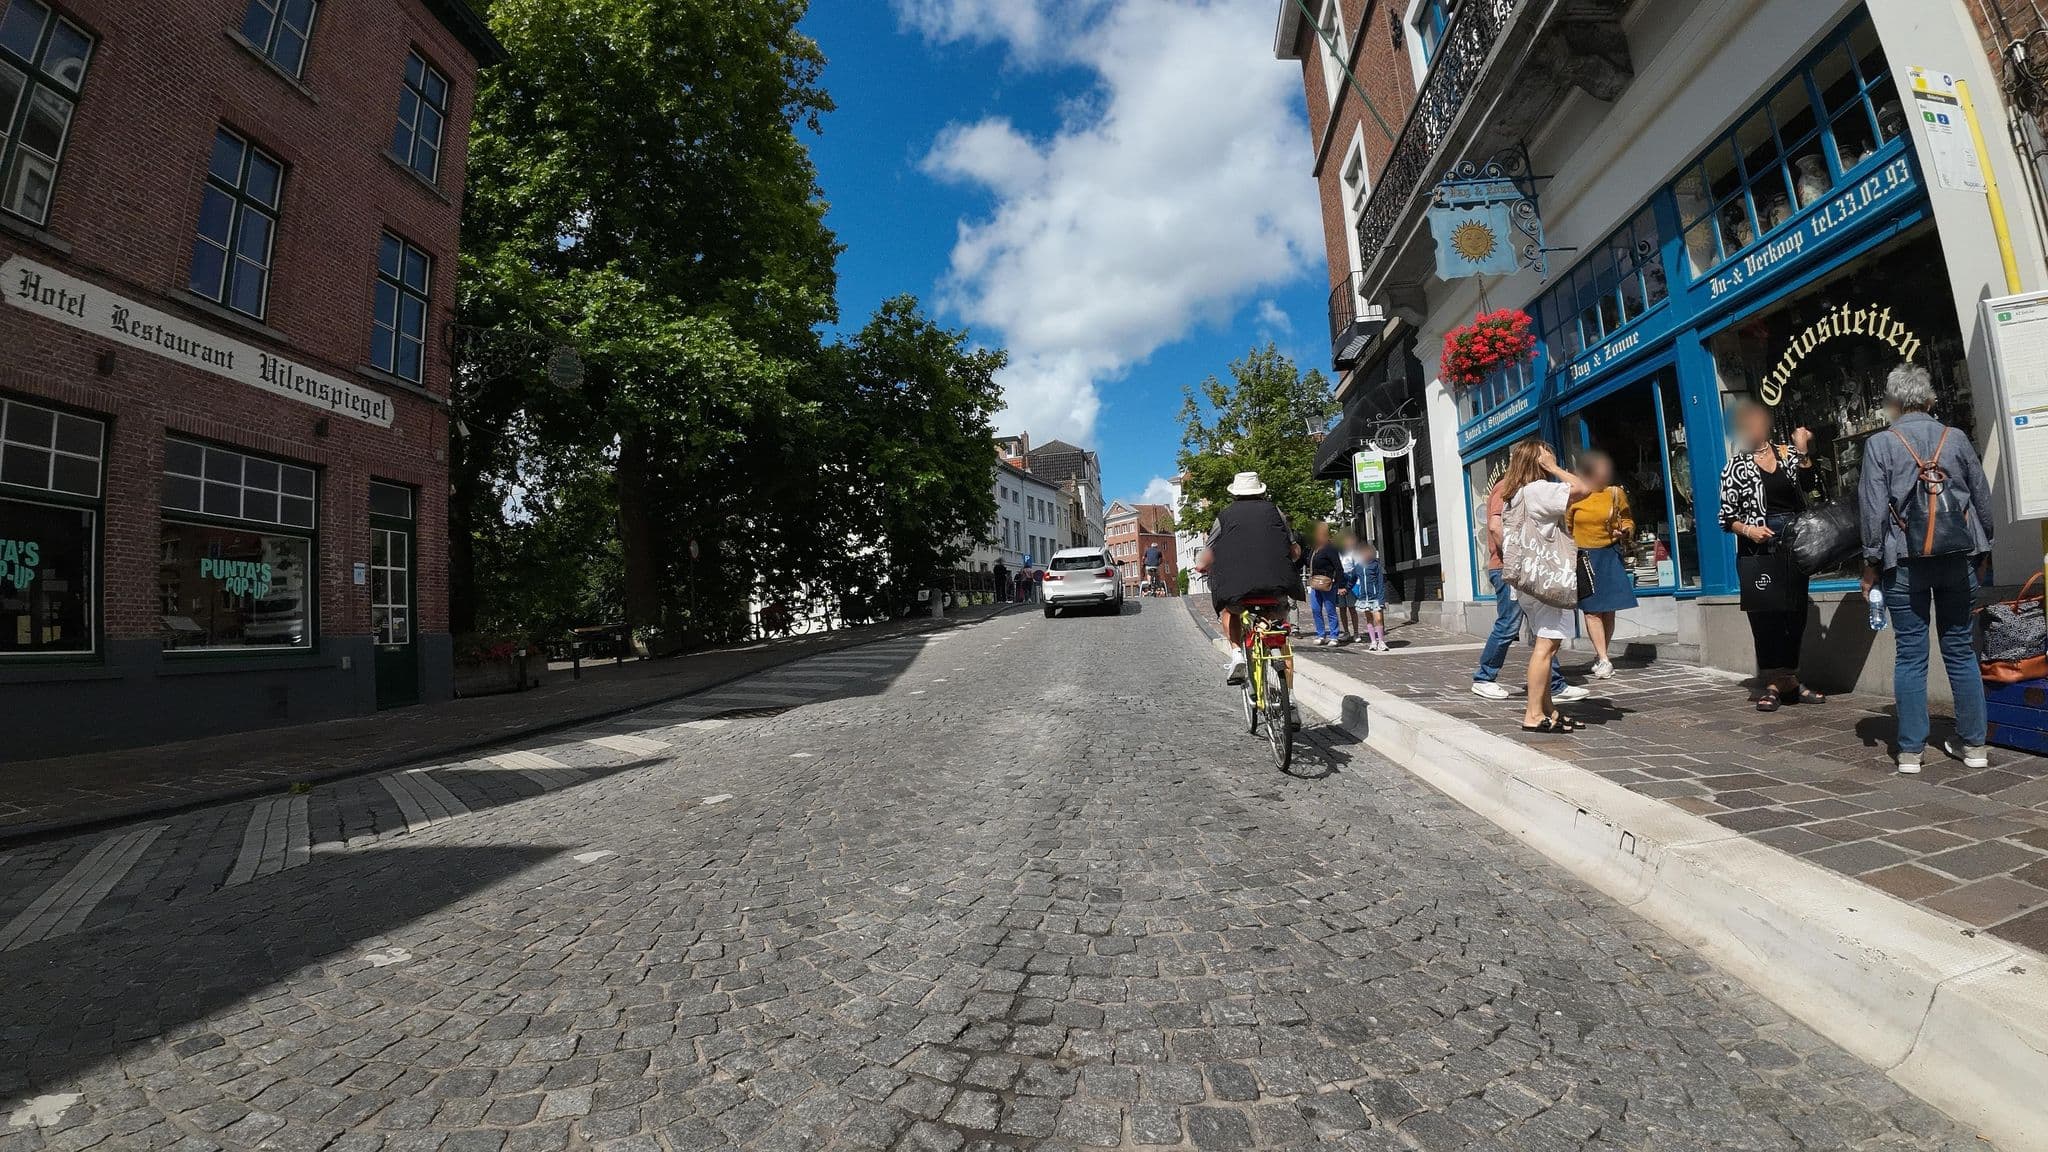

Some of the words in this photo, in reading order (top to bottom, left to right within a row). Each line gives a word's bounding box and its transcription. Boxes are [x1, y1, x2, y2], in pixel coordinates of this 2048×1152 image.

[1744, 230, 1804, 276] Verkoop
[16, 268, 86, 318] Hotel
[110, 304, 235, 370] Restaurant
[259, 353, 387, 420] Uilenspiegel
[1569, 361, 1591, 379] Dag
[1593, 353, 1601, 367] &
[1604, 331, 1639, 362] Zonne
[1760, 301, 1921, 406] Curiositeiten
[200, 558, 272, 582] PUNTA'S
[225, 577, 269, 600] POP-UP
